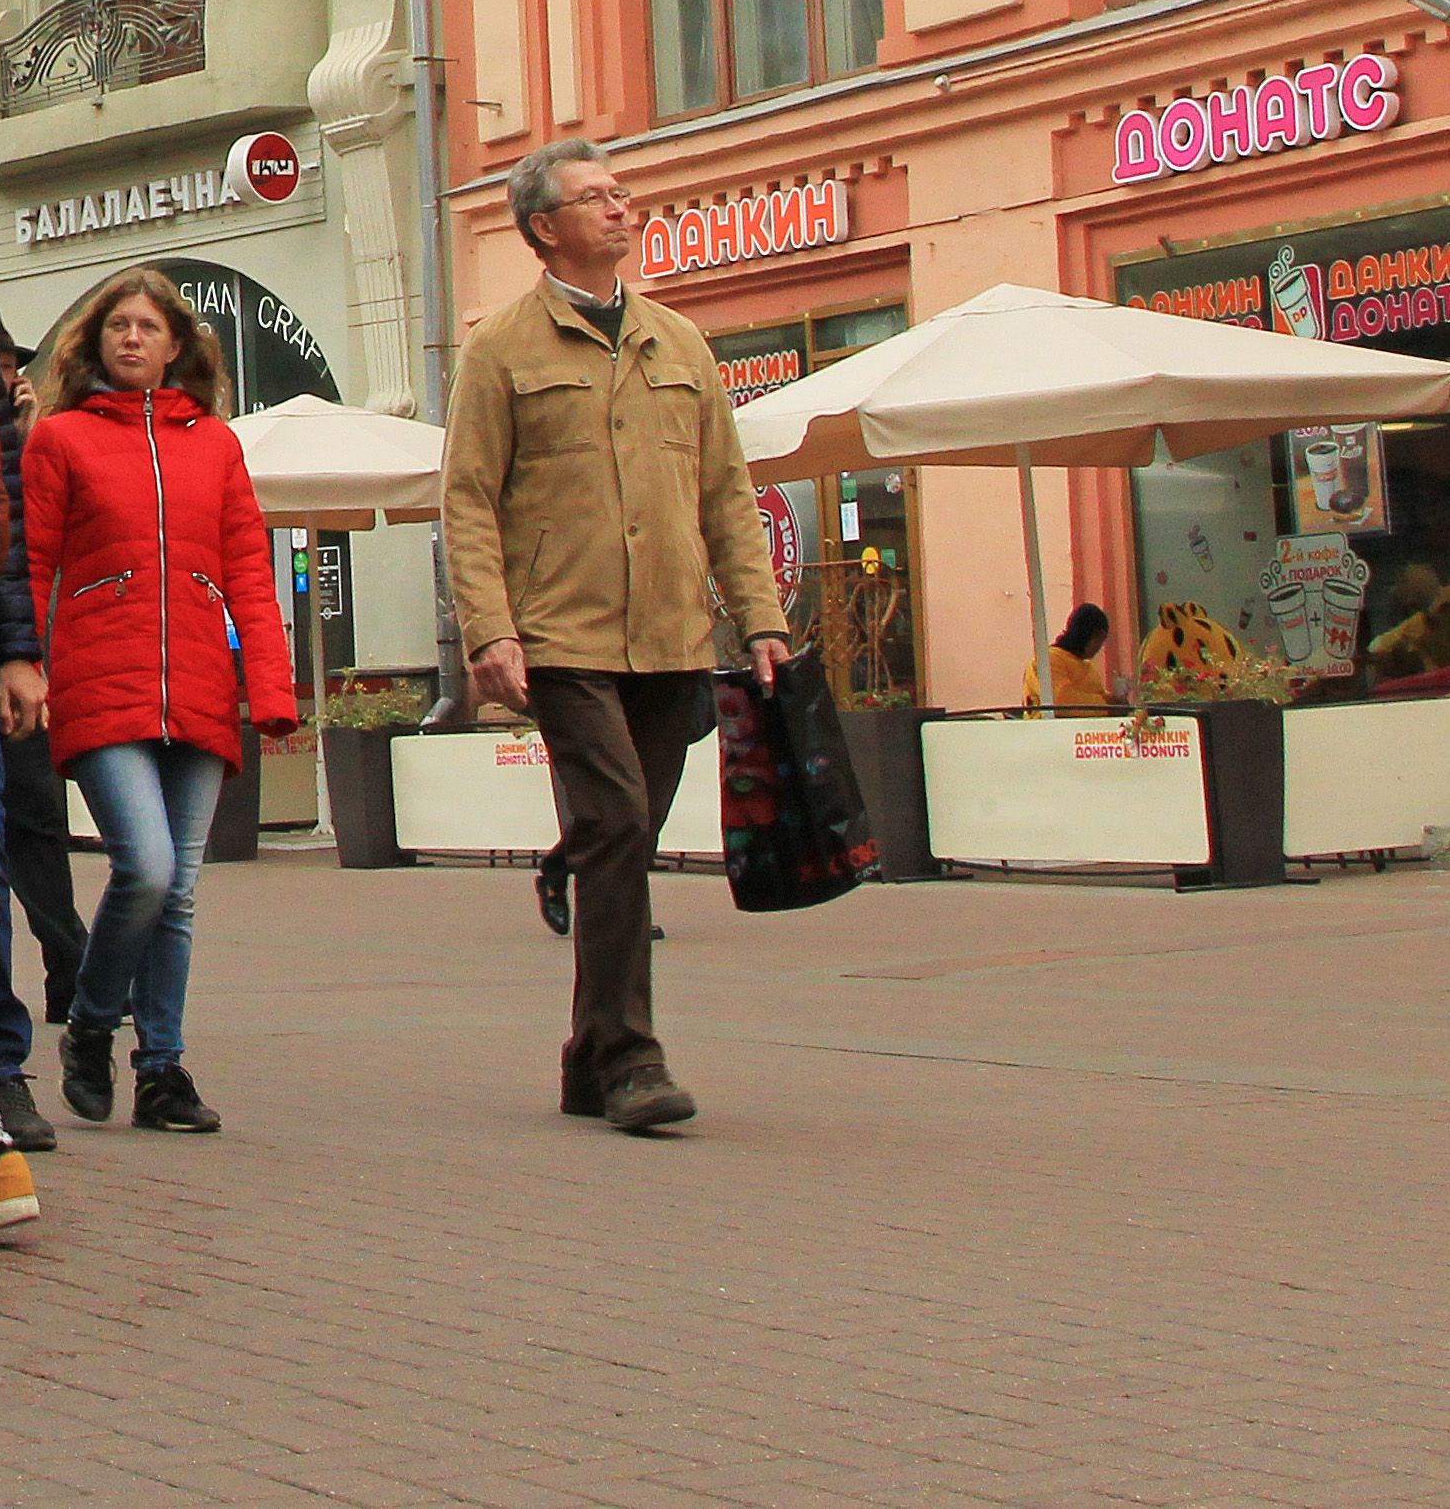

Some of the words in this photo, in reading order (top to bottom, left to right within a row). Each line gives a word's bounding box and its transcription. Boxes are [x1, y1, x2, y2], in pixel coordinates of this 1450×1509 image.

[1111, 53, 1386, 184] ДОНАТС
[14, 169, 242, 244] БАЛАЛАЕЧНА
[640, 179, 838, 279] ДАНКИН
[1329, 242, 1450, 299] ДАНКИ
[180, 282, 237, 317] SIAN
[1331, 283, 1450, 341] ДОНАТ
[716, 349, 798, 392] АНКИН
[1075, 746, 1122, 759] ДОНАТС
[1140, 744, 1190, 758] DONUTS
